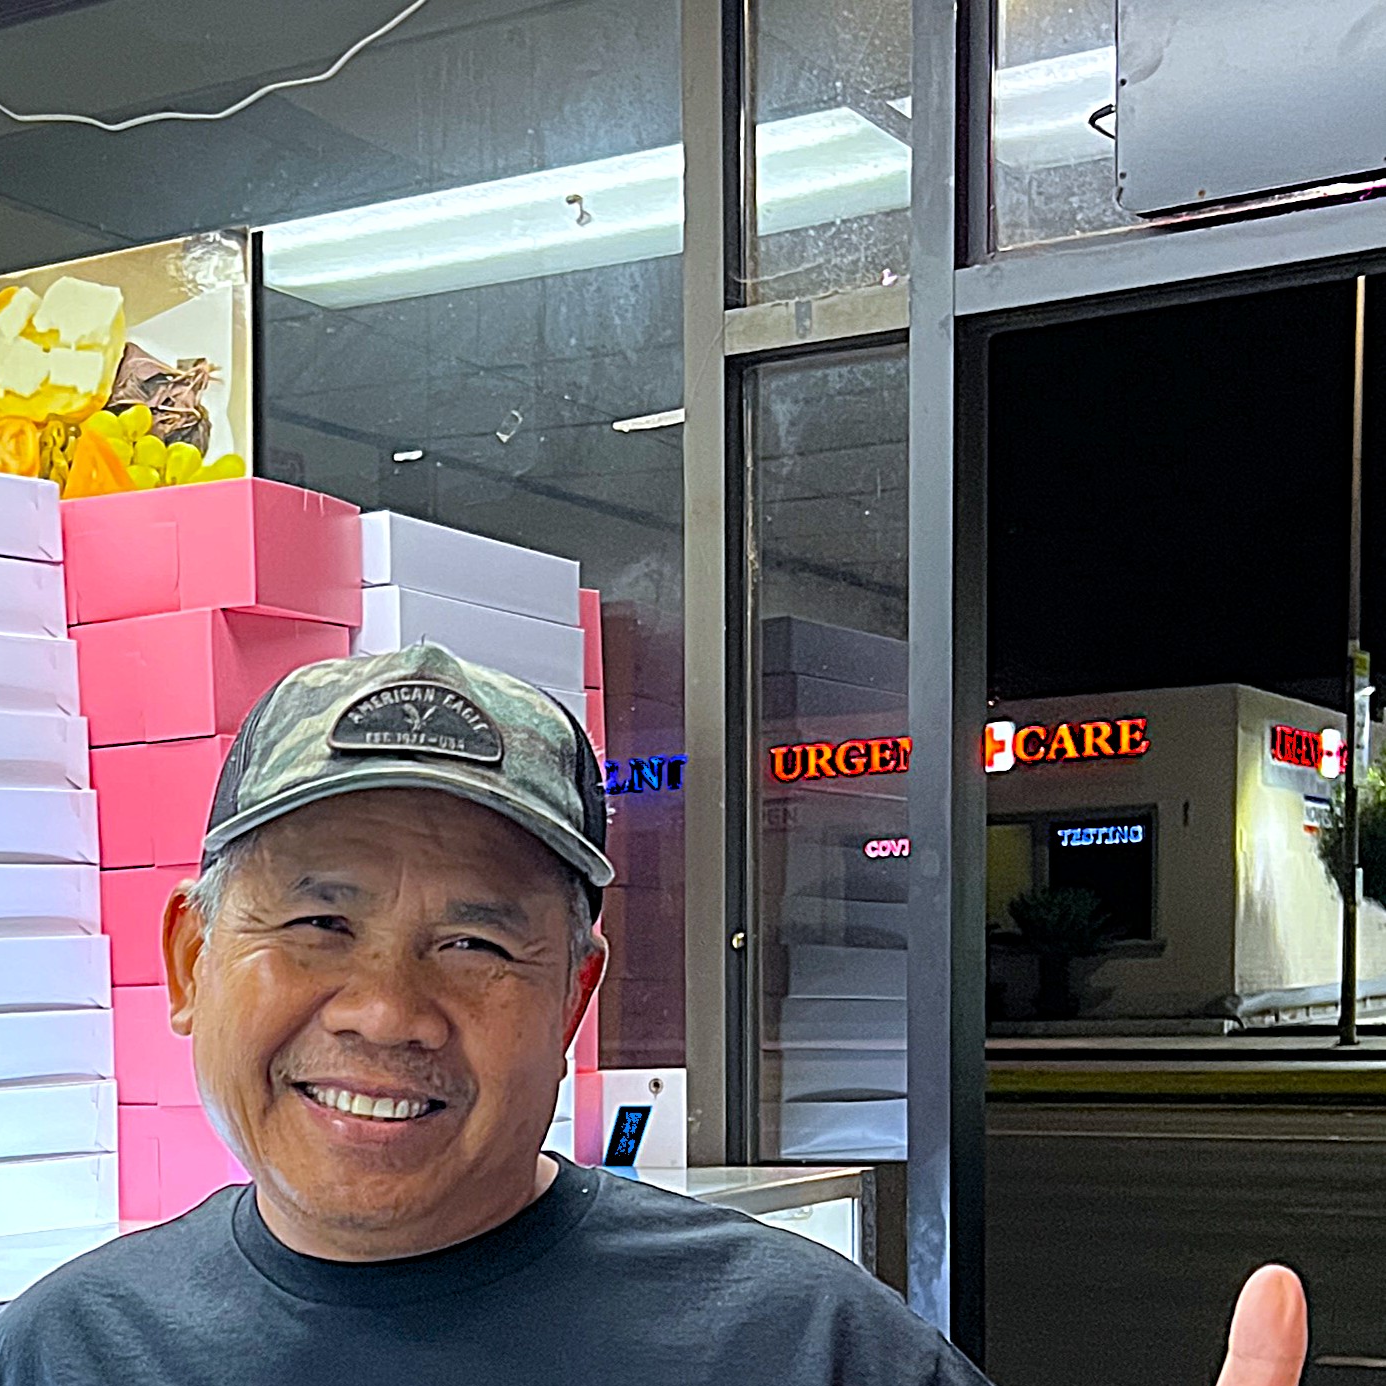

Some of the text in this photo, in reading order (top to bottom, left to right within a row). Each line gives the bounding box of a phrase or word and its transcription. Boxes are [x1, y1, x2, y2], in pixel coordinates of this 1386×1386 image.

[347, 686, 490, 732] AMERICAN EAGLE
[1014, 715, 1151, 764] CARE
